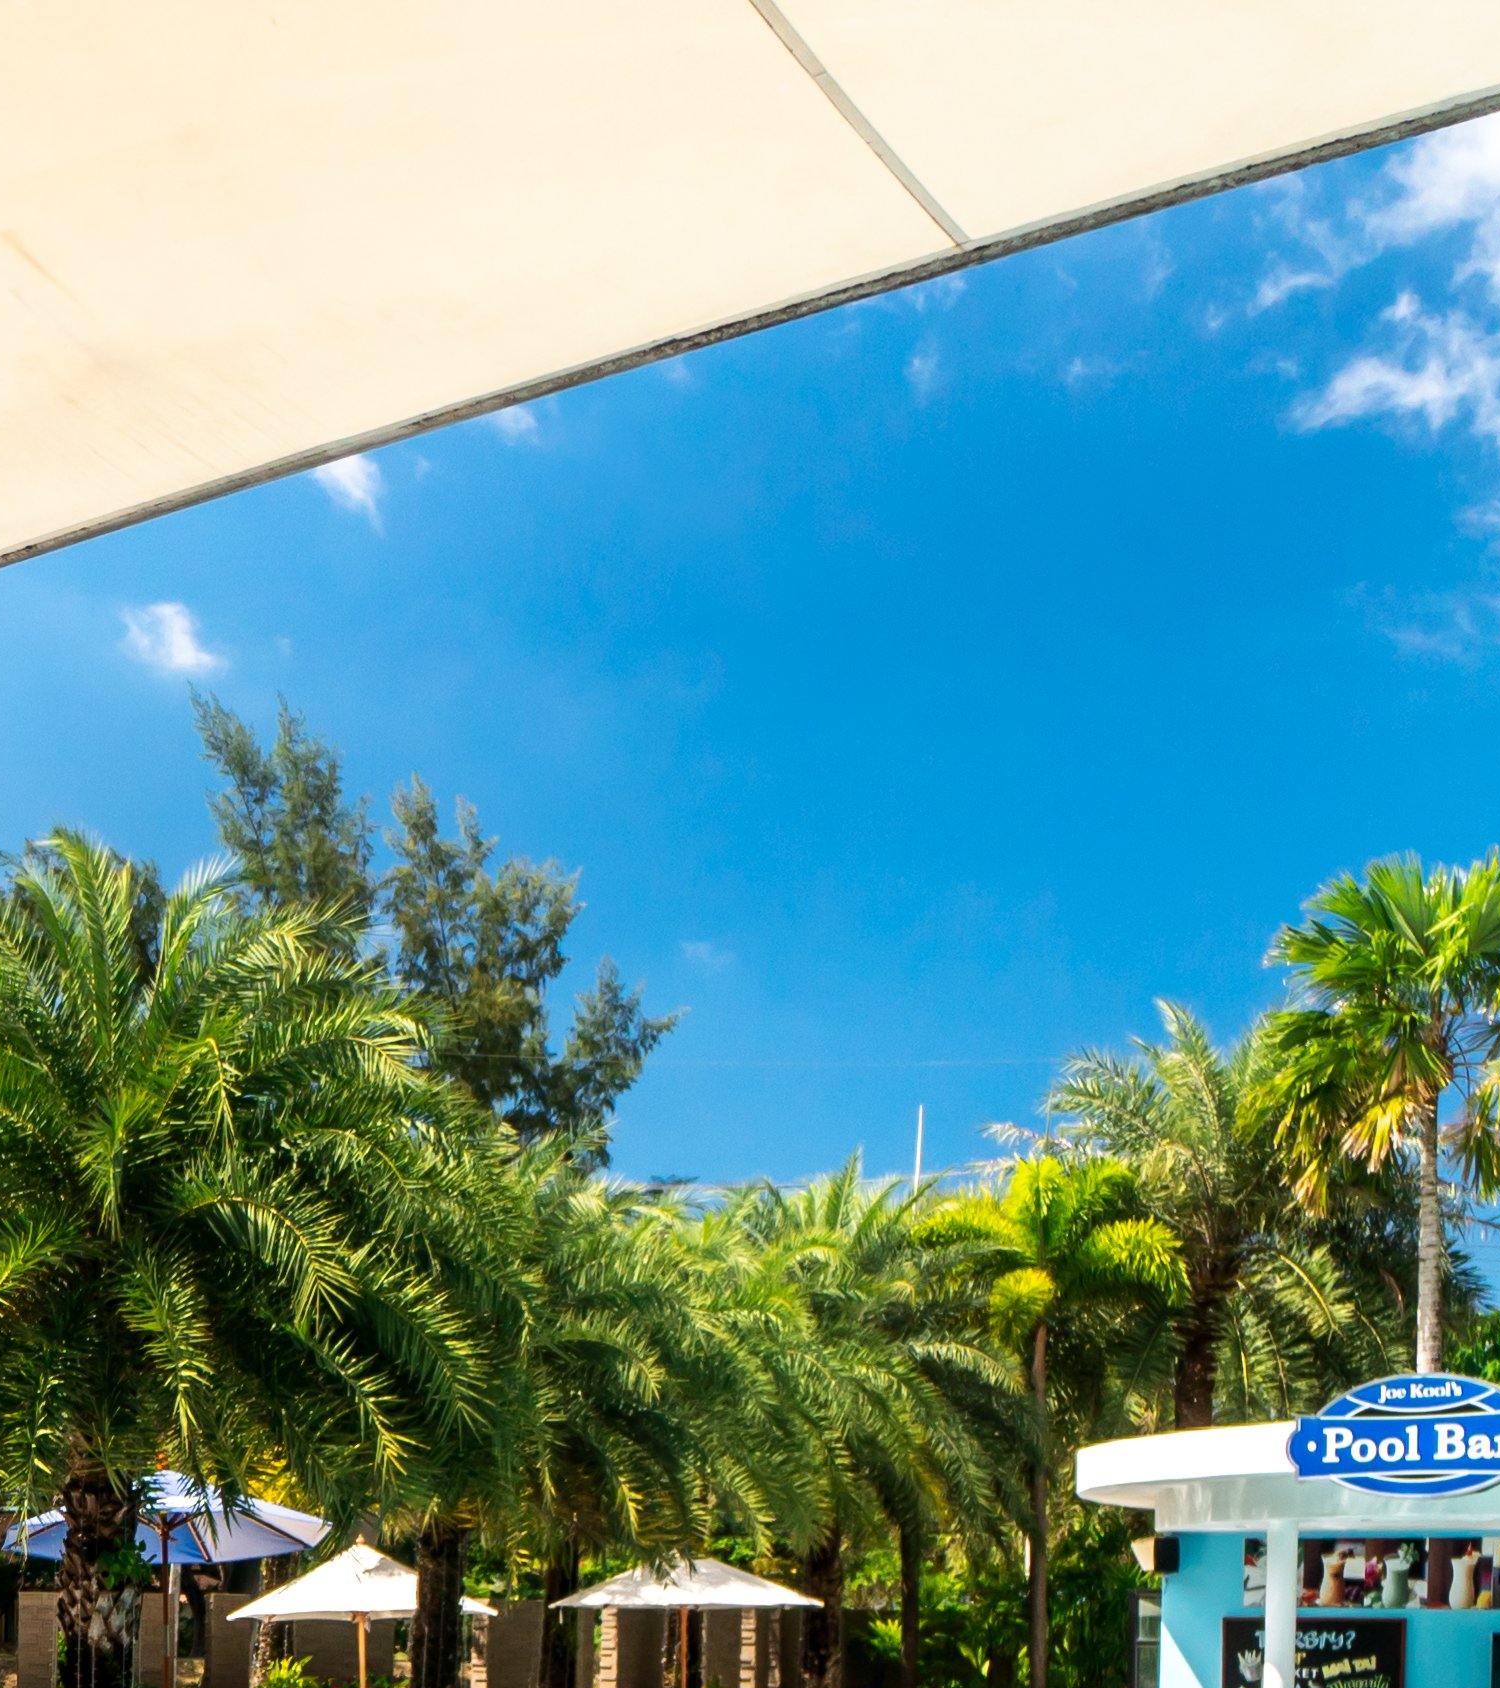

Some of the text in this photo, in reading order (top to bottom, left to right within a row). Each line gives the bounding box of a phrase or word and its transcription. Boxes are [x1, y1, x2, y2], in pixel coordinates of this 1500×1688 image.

[1378, 1382, 1462, 1404] Joe Kool's
[1322, 1425, 1420, 1463] Pool
